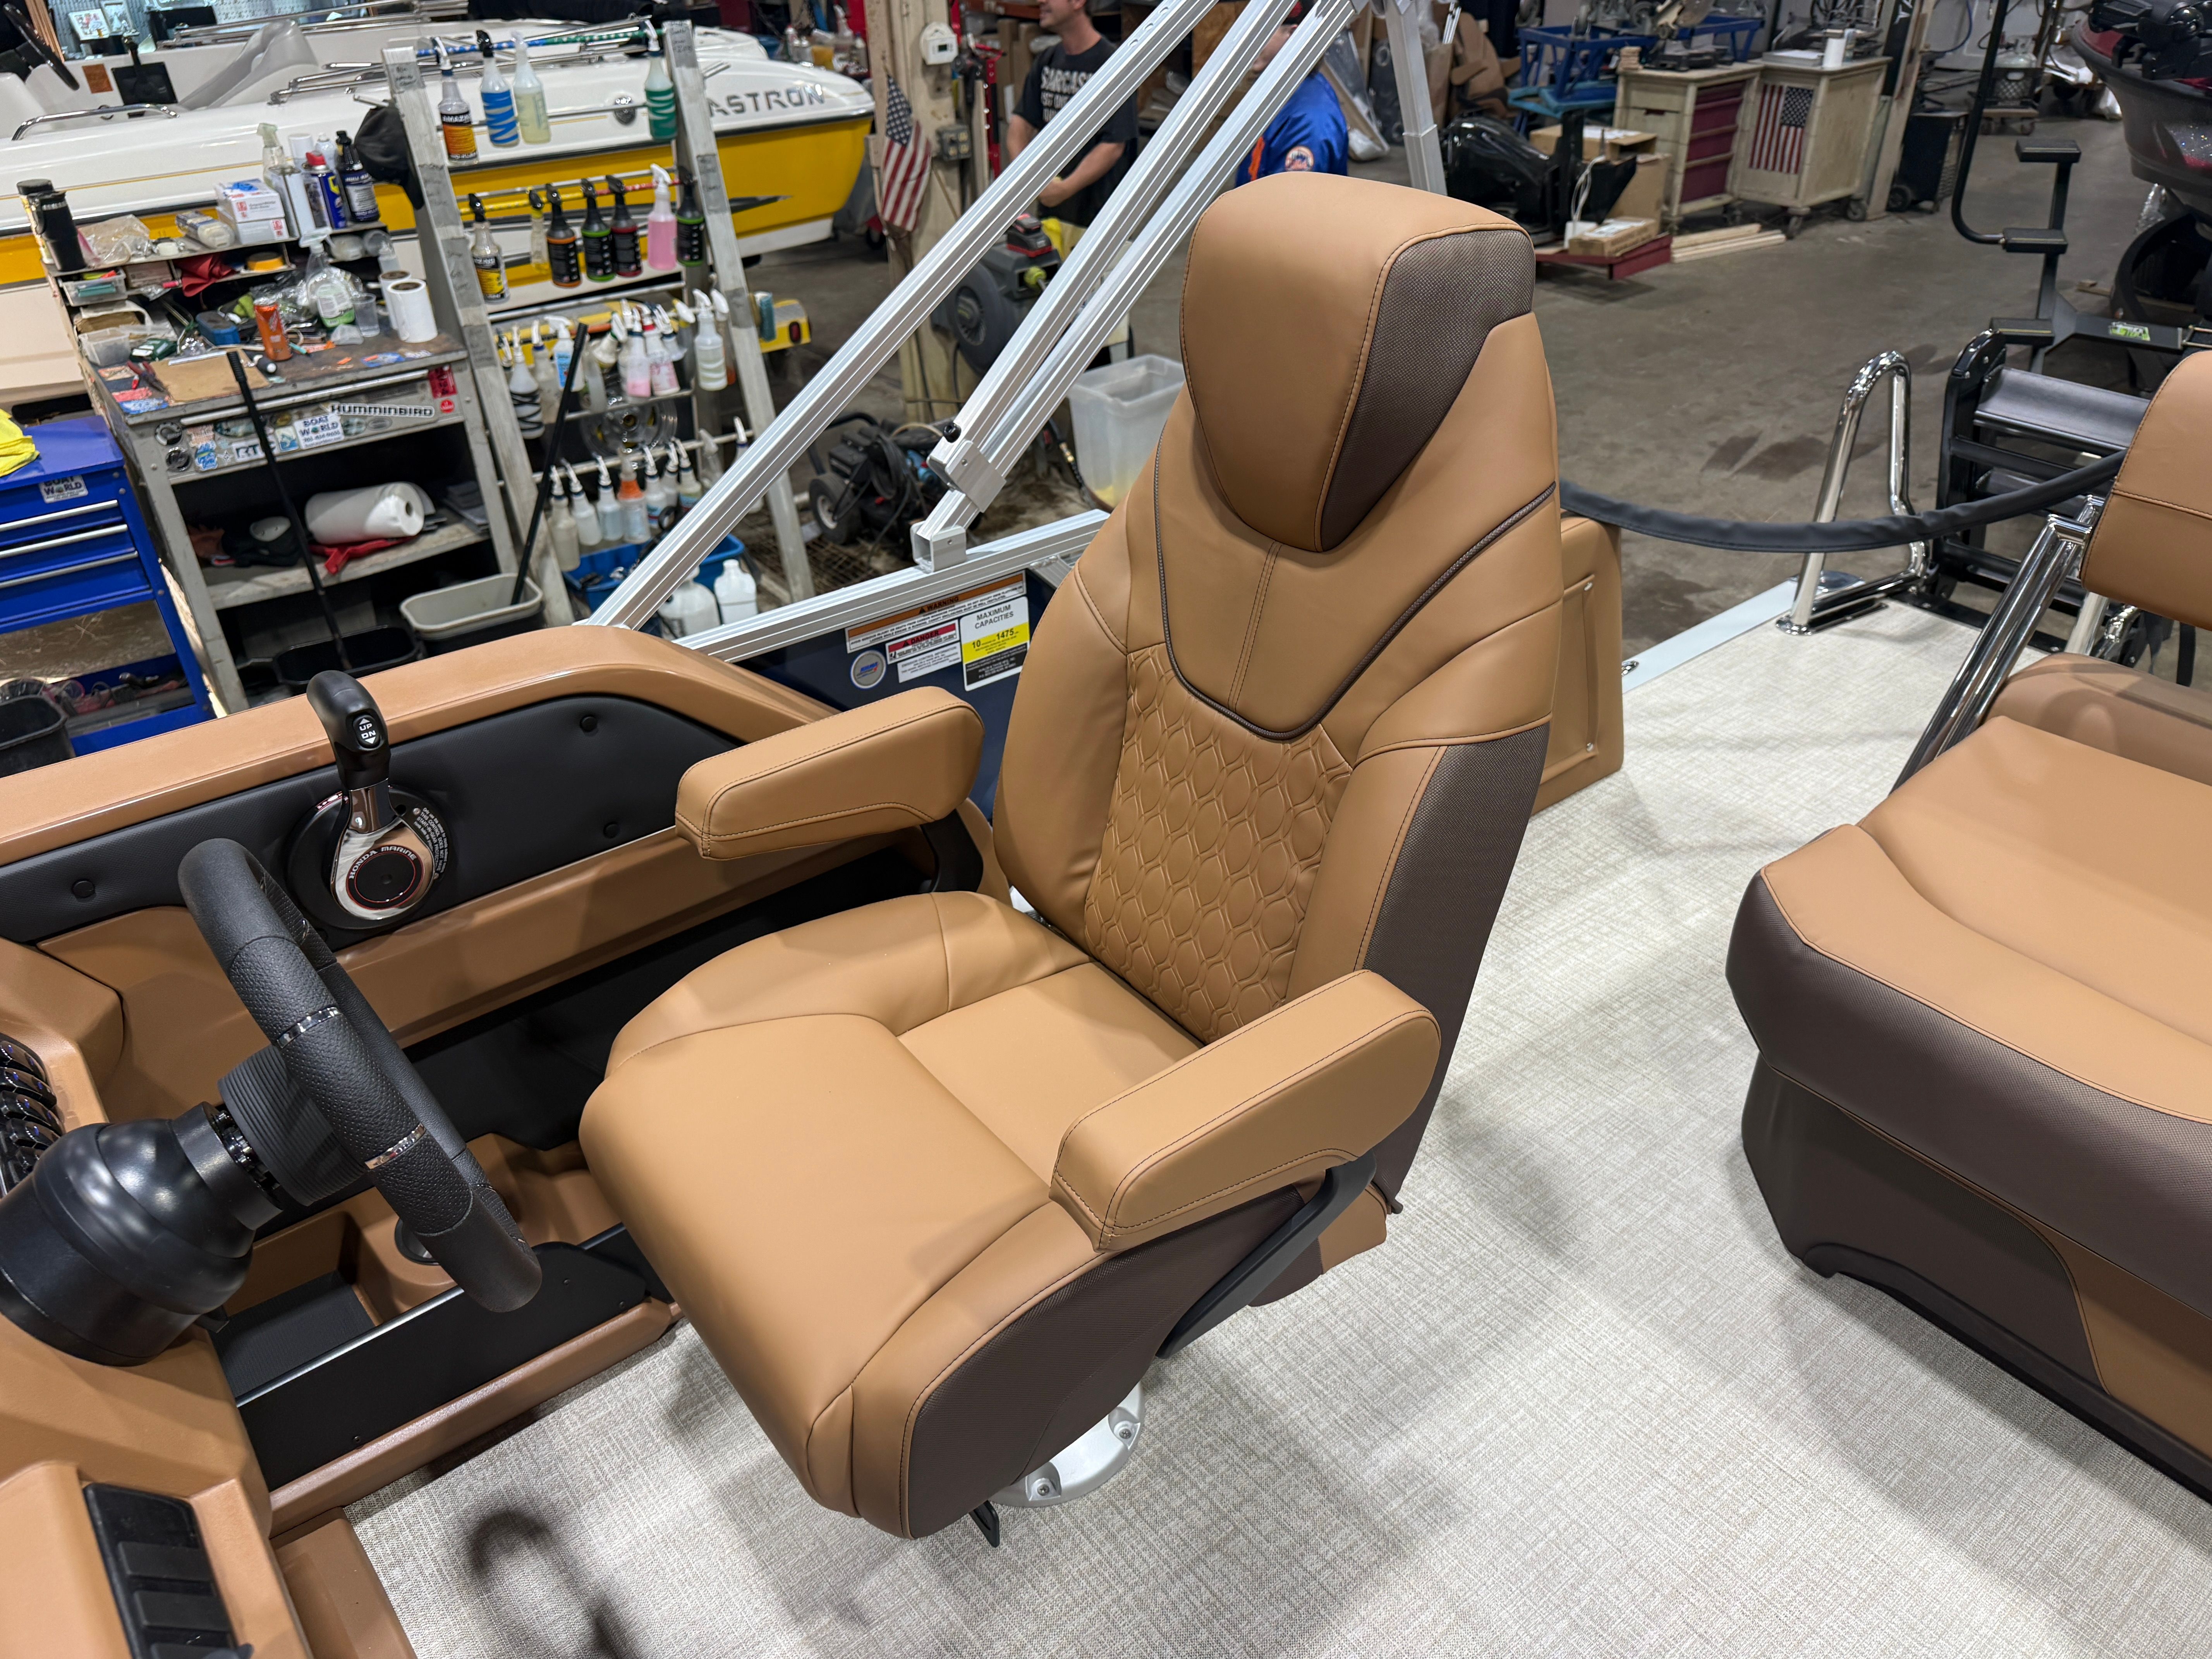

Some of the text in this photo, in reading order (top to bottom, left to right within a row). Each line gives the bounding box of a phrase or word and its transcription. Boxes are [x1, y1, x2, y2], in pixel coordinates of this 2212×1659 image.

[706, 84, 825, 117] ASTRON
[331, 404, 433, 416] HUMMINBIRD
[303, 416, 329, 427] BOAT
[927, 596, 959, 611] WARNING
[975, 611, 1014, 629] CAPACITIES
[976, 604, 1011, 621] MAXIMUM
[911, 630, 939, 645] DANGER
[972, 640, 981, 649] 10
[997, 628, 1014, 640] 1475
[359, 723, 372, 731] UP
[361, 730, 376, 739] DN
[421, 812, 429, 820] THIS
[428, 819, 440, 837] CONTROL
[349, 846, 417, 879] HONDA MARINE
